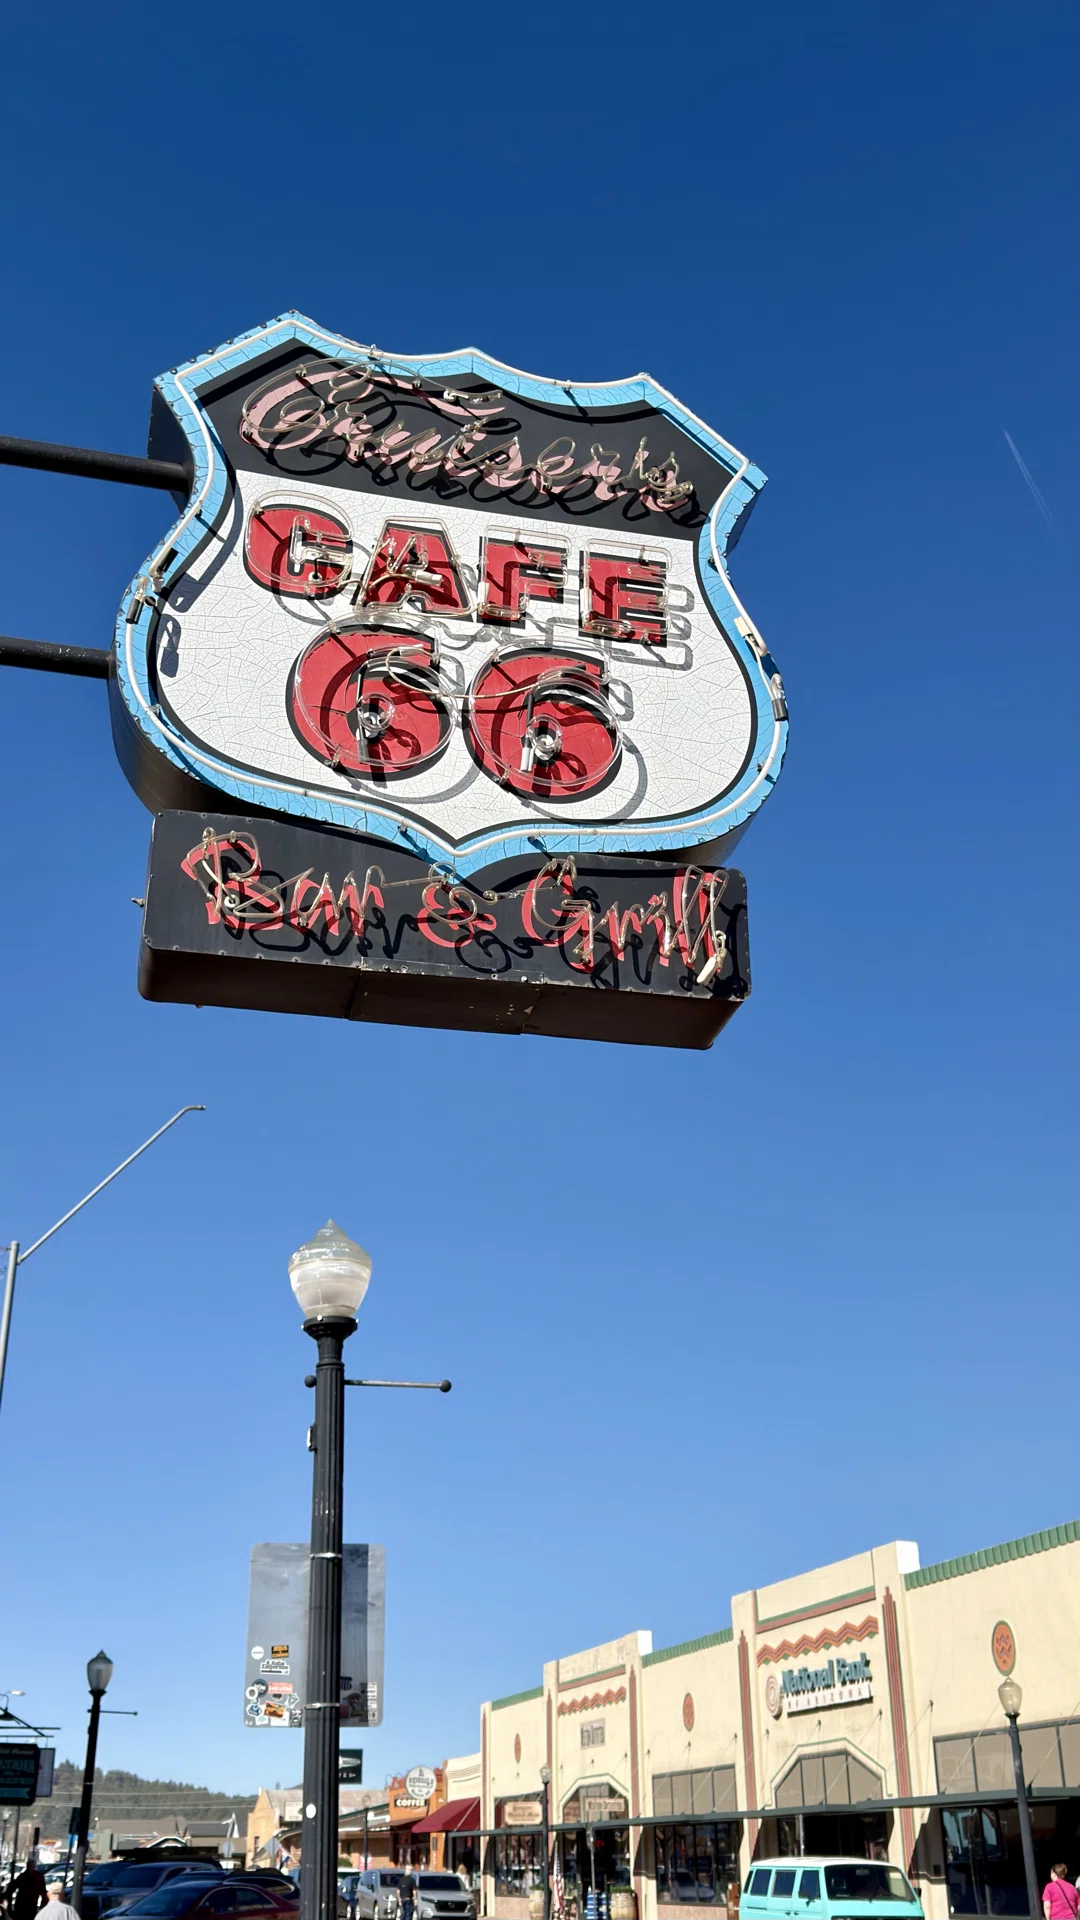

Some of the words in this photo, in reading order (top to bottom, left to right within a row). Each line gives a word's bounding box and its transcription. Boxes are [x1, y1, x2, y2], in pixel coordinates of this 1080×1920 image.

[240, 362, 697, 513] Cruiser's
[243, 493, 669, 648] CAFE
[286, 614, 624, 804] 66
[180, 830, 385, 938] Bar
[416, 874, 498, 948] &
[521, 858, 729, 976] Grill
[781, 1658, 835, 1696] National
[836, 1652, 872, 1685] Bank
[788, 1699, 799, 1710] OF
[806, 1686, 863, 1707] ARIZONA
[396, 1799, 425, 1807] COFFEE
